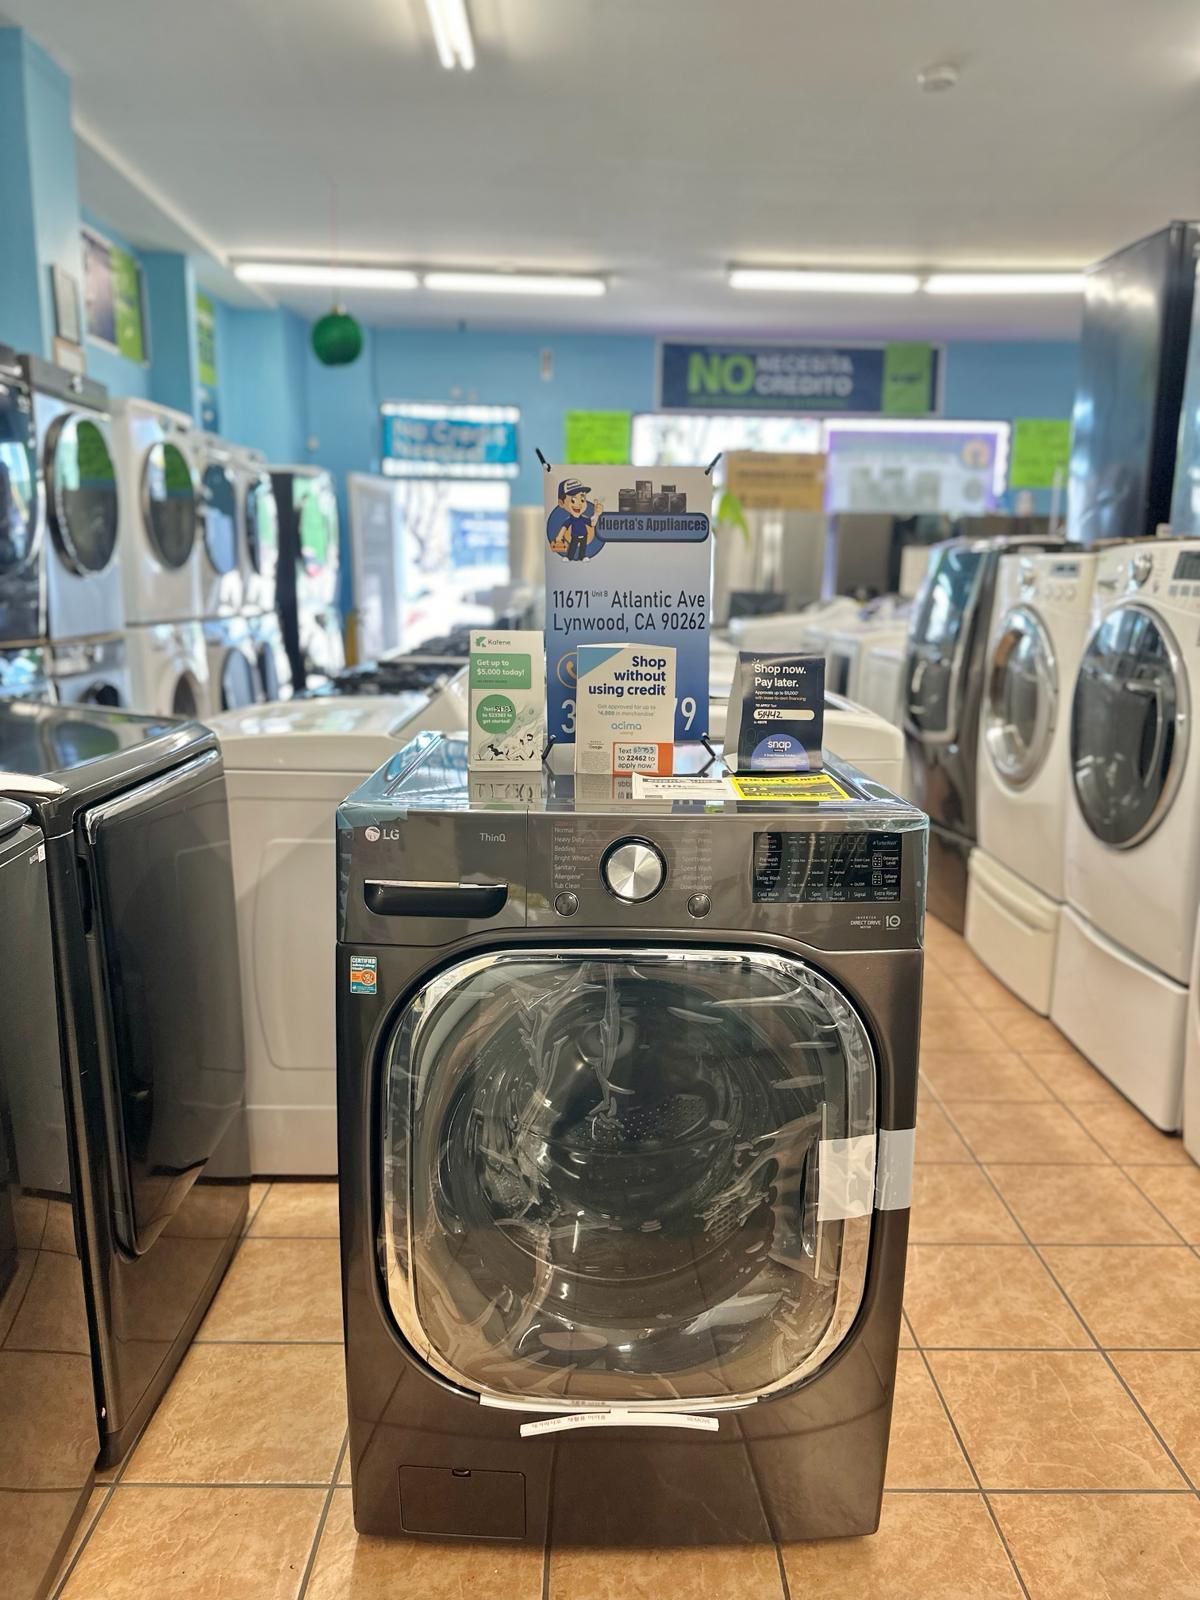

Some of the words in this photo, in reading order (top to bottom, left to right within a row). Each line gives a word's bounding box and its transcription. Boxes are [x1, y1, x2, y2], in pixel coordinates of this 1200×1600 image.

[688, 352, 754, 396] NO
[600, 517, 644, 531] Huerta's
[646, 518, 707, 533] Appliances
[553, 590, 589, 608] 11671
[611, 590, 672, 608] Atlantic
[677, 590, 705, 608] Ave
[553, 613, 629, 635] Lynwood,
[635, 613, 656, 630] CA
[661, 613, 705, 630] 90262
[491, 660, 500, 668] up
[632, 655, 666, 669] Shop
[502, 668, 525, 678] today!
[754, 664, 780, 675] Shop
[782, 666, 807, 674] now.
[614, 669, 666, 682] without
[754, 677, 773, 688] Pay
[774, 677, 799, 687] later.
[588, 683, 624, 697] using
[627, 684, 666, 696] credit
[611, 720, 642, 730] acima
[767, 740, 792, 752] snap
[618, 762, 636, 770] apply
[382, 829, 400, 840] LG
[480, 832, 507, 842] ThinQ
[554, 836, 571, 844] Heavy
[554, 845, 576, 853] Bedding
[554, 864, 576, 872] Sanitary
